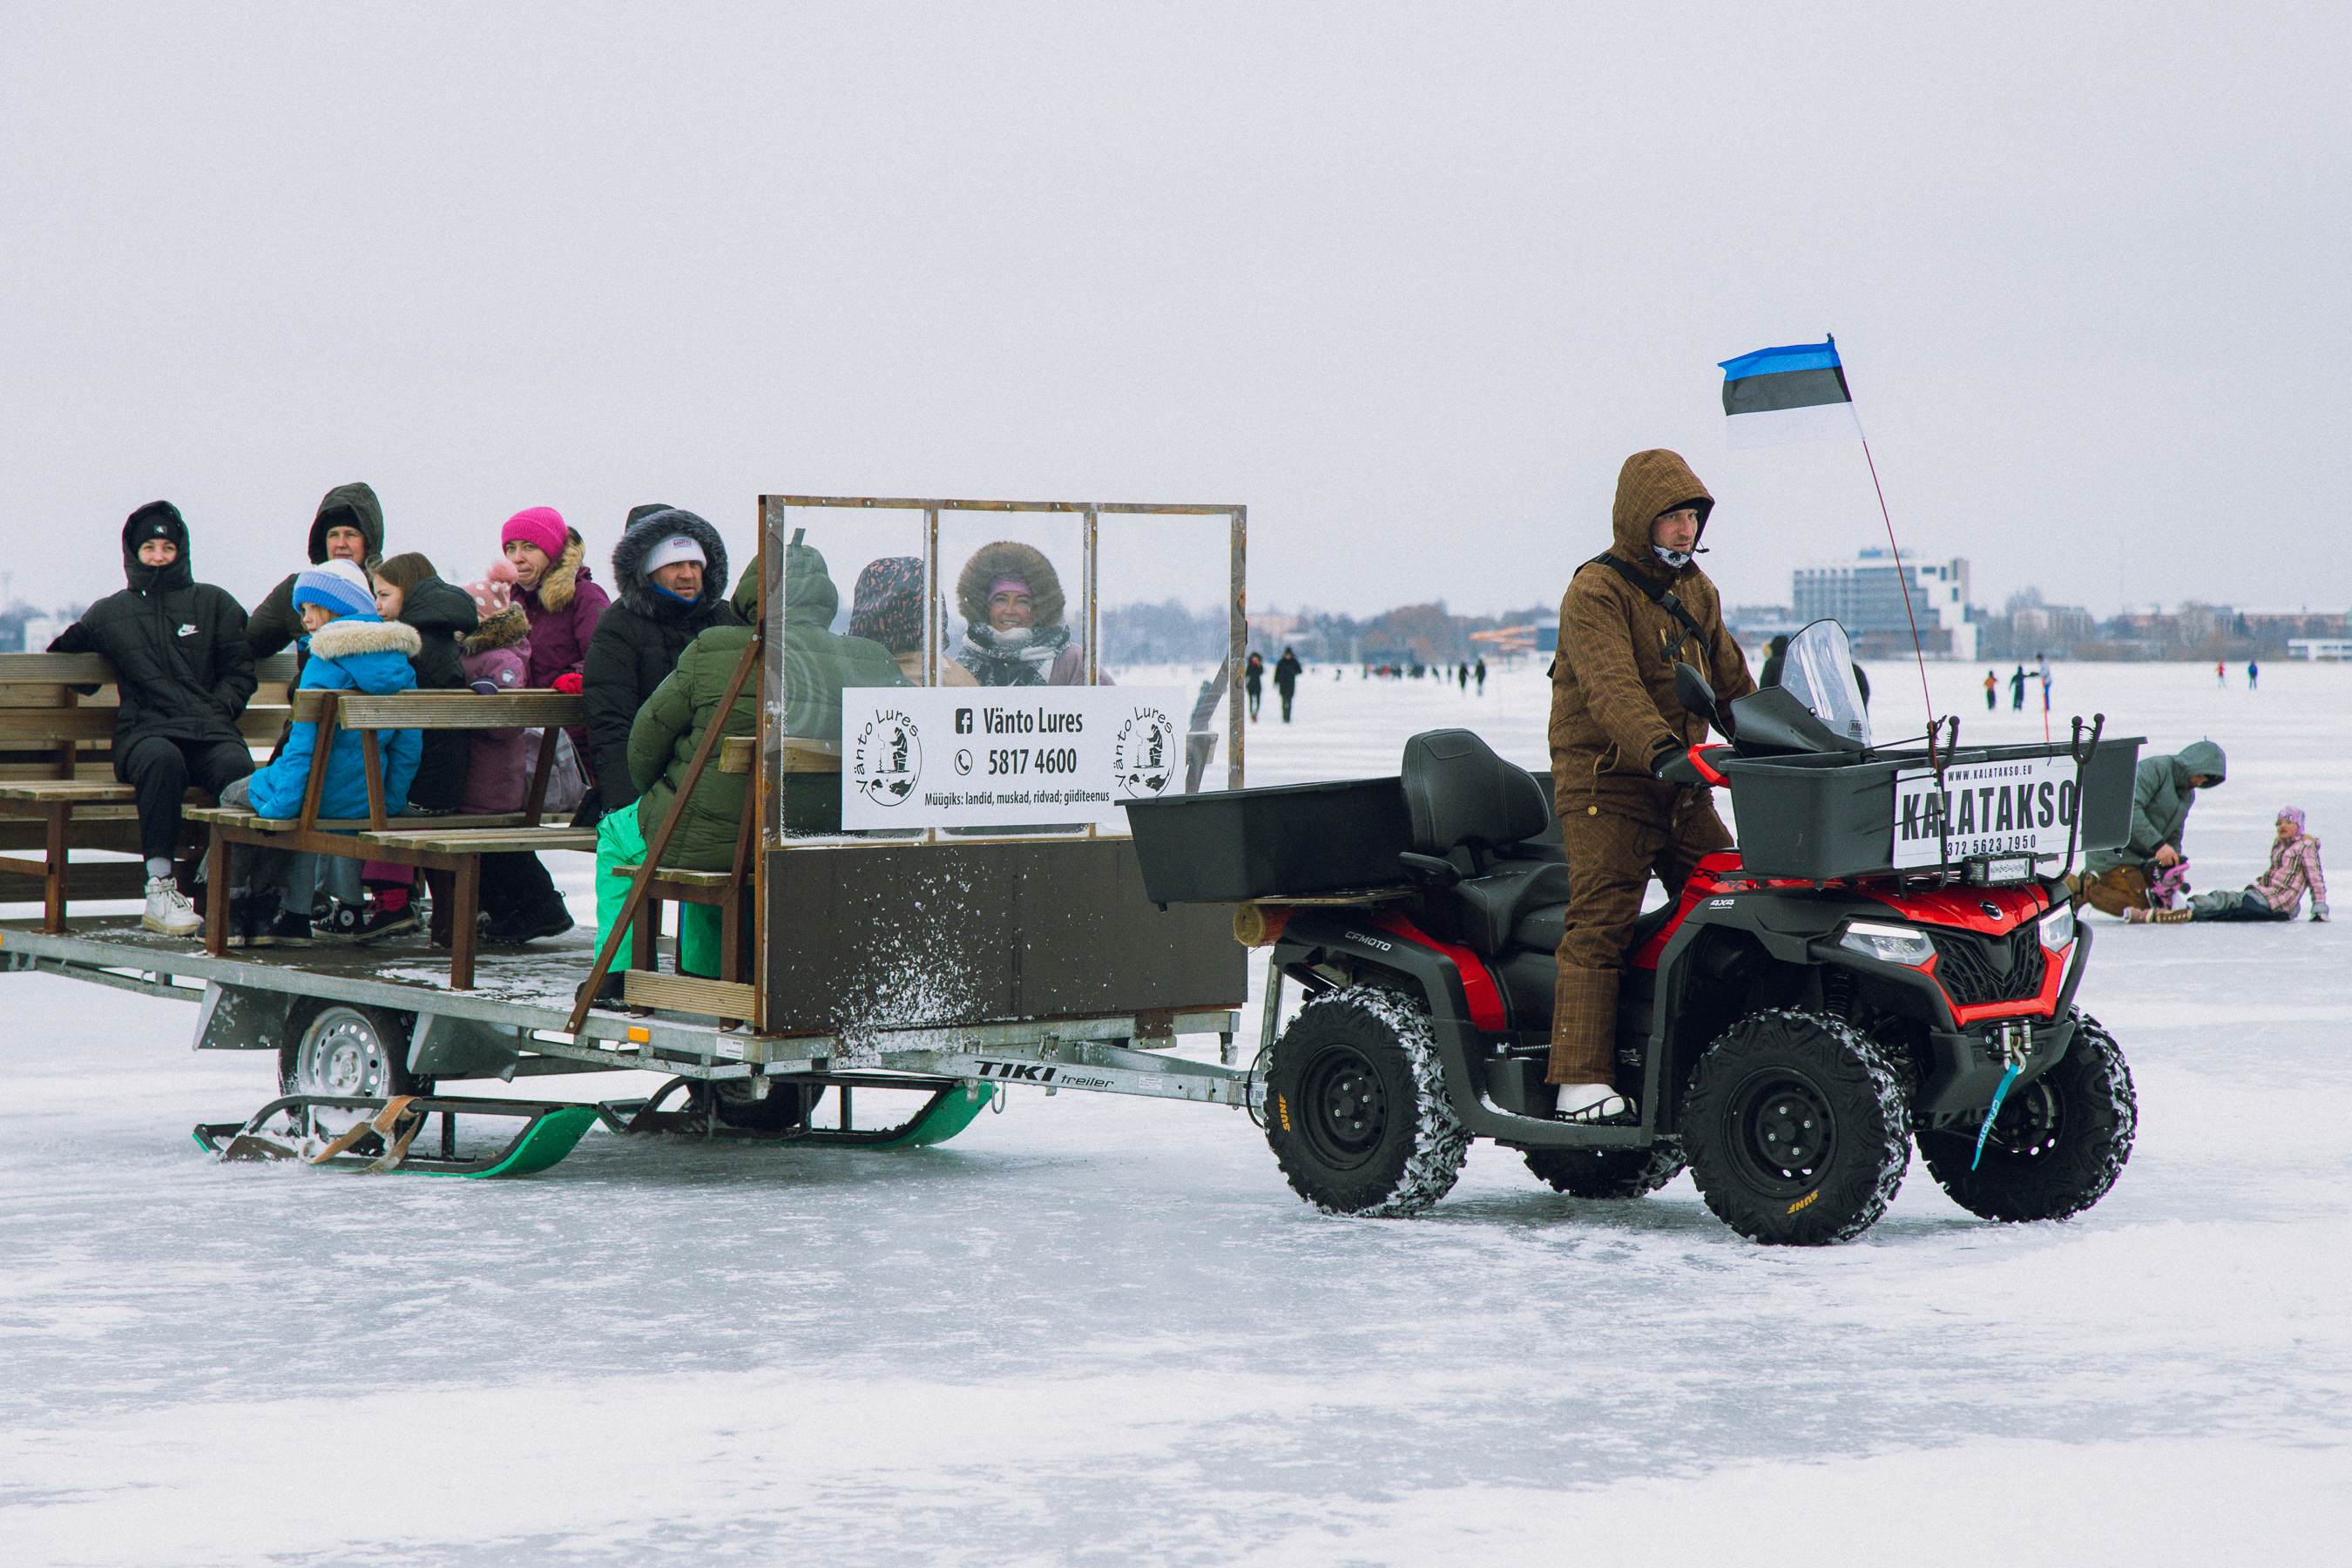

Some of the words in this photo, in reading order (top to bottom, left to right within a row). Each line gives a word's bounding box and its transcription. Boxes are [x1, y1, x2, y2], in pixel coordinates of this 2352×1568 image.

[983, 706, 1034, 734] Vänto
[1038, 706, 1084, 733] Lures
[854, 721, 873, 794] Vänto
[875, 708, 919, 738] Lures
[988, 748, 1030, 775] 5817
[1034, 747, 1078, 774] 4600
[1113, 719, 1132, 788] Vänto
[1133, 706, 1173, 734] Lures
[1947, 763, 2033, 782] WWW.KALATAKSO.EU
[924, 791, 963, 809] Müügiks:
[965, 791, 995, 807] landid,
[997, 790, 1031, 806] muskad,
[1033, 789, 1063, 805] ridvad;
[1064, 788, 1110, 806] giiditeenus
[1901, 779, 2076, 841] KALATAKSO
[1972, 837, 2002, 855] 5623
[2007, 834, 2037, 852] 7950
[1344, 930, 1392, 951] CFMOTO
[974, 1059, 1058, 1083] TIKI
[1061, 1074, 1115, 1088] treiler
[1279, 1092, 1291, 1132] SUNF
[1977, 1099, 2000, 1149] CFMOTO
[1787, 1189, 1819, 1214] SUNF
